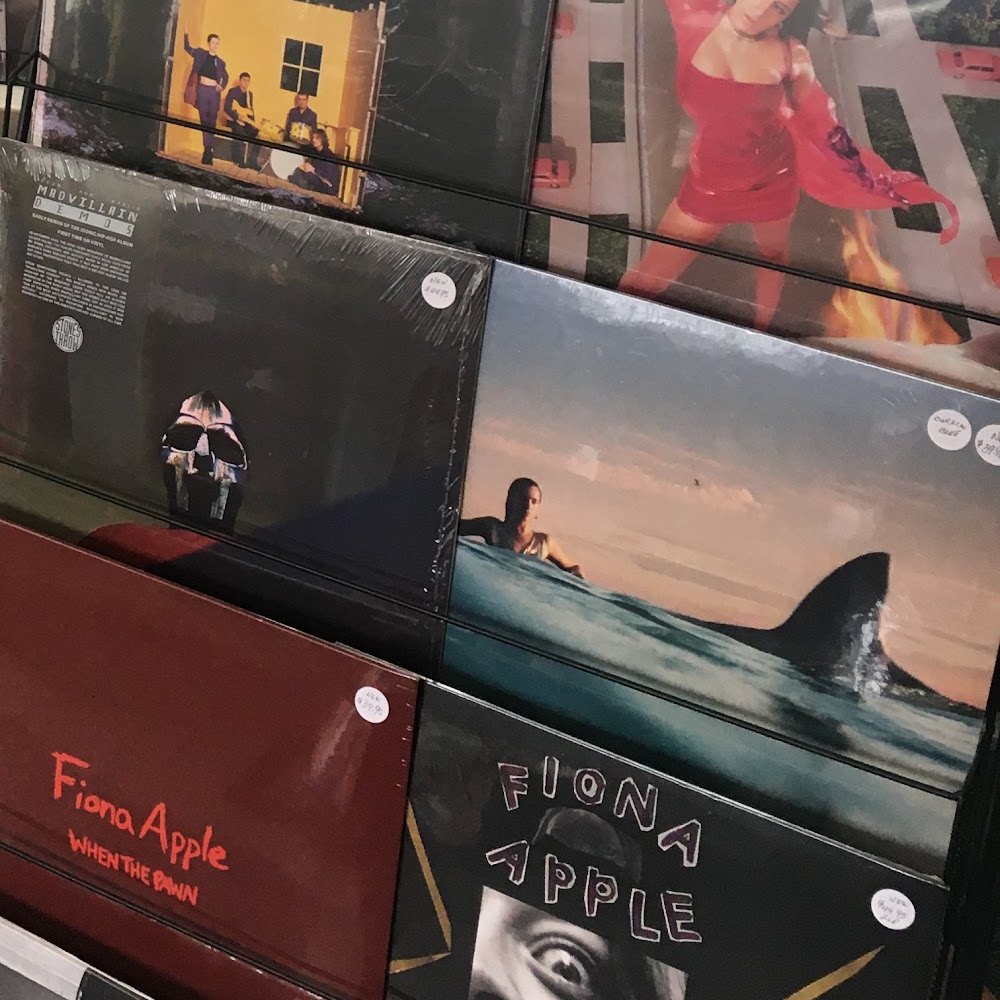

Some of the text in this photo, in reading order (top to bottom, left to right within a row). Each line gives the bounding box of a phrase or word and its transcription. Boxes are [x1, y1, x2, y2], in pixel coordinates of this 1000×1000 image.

[36, 183, 139, 223] MADVILLAIN
[54, 331, 79, 350] THROW
[55, 318, 81, 337] STONES
[51, 751, 230, 871] Fiona Apple
[497, 755, 702, 868] FIONA
[68, 828, 199, 906] WHEN THE PAWN
[485, 839, 703, 943] APPLE
